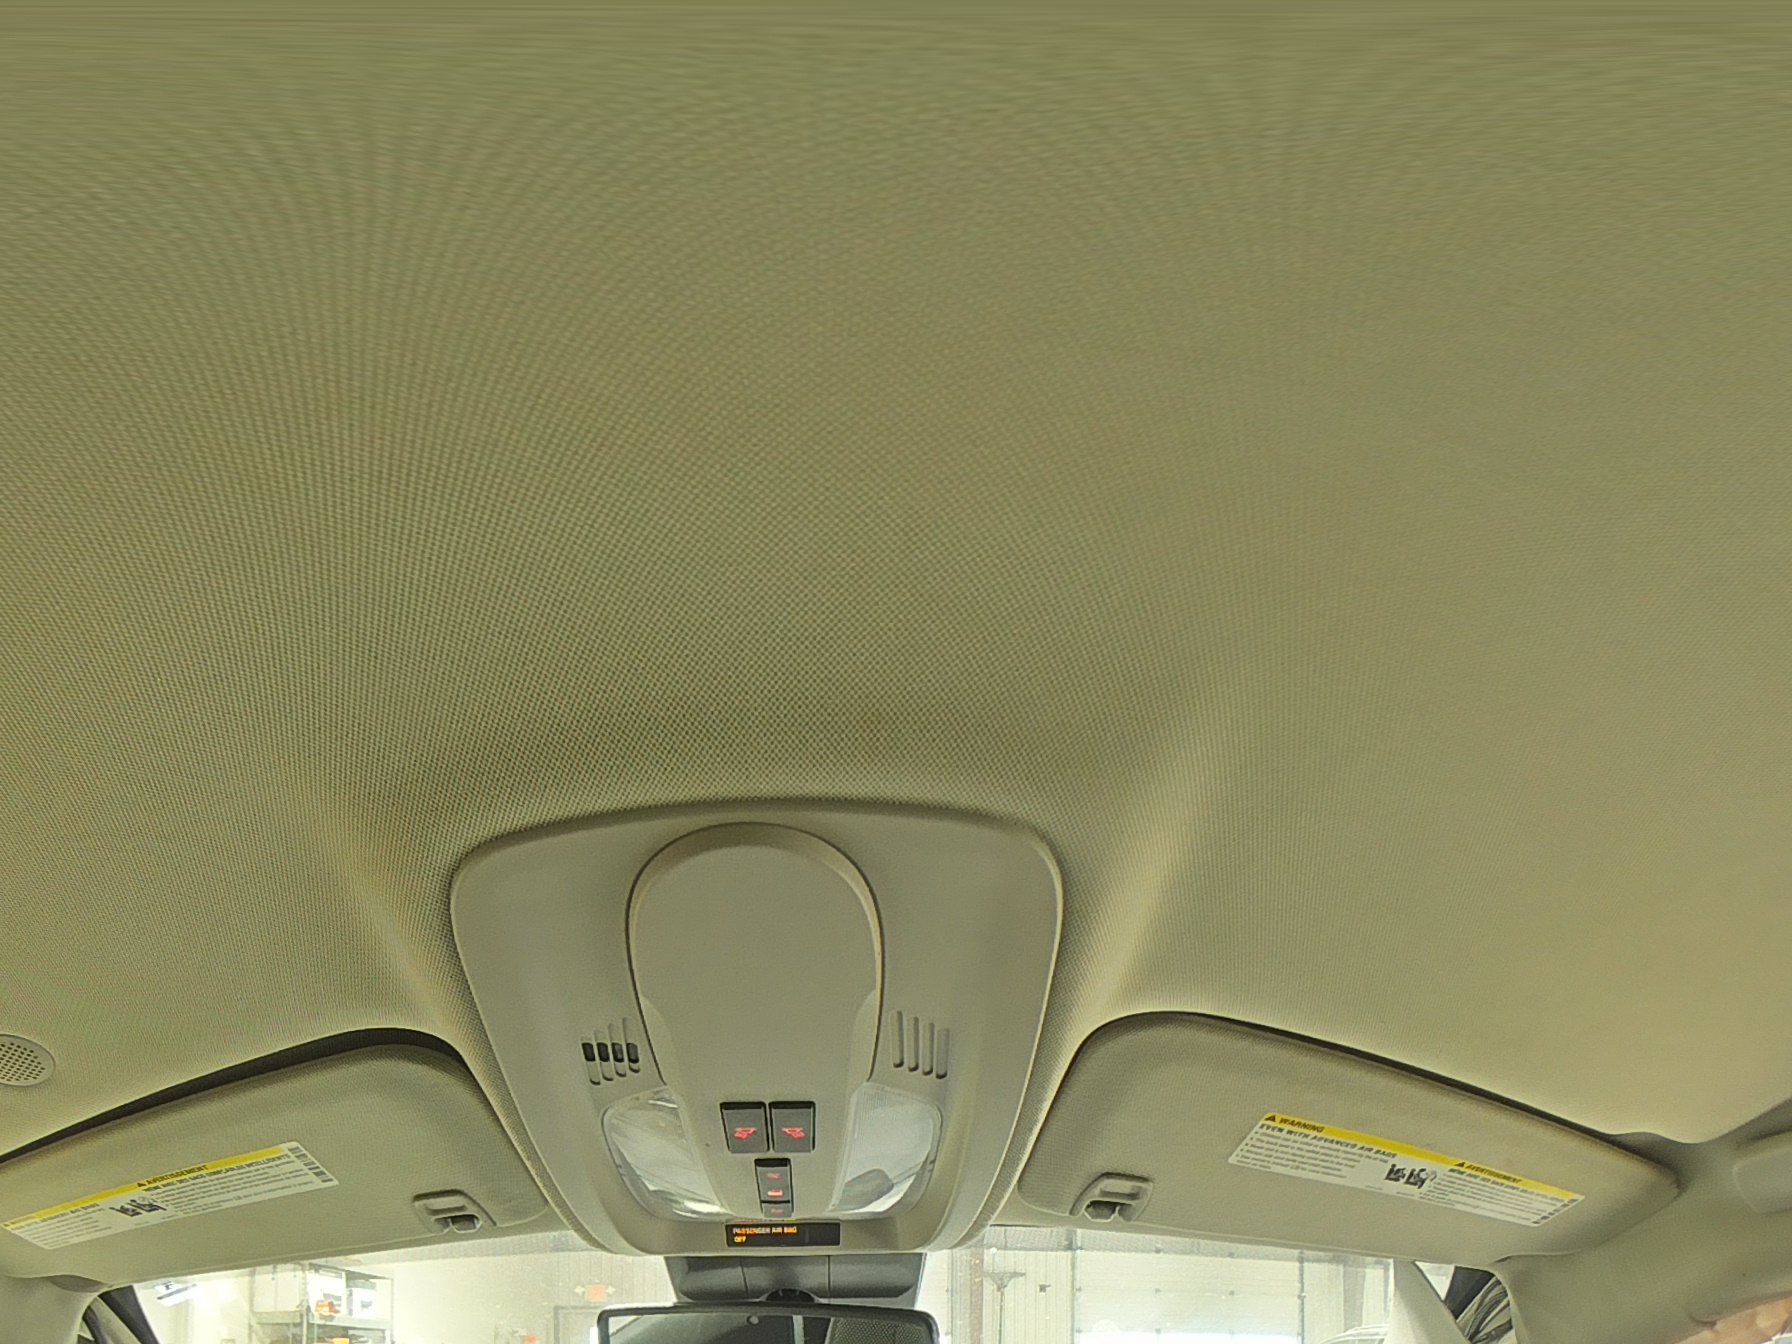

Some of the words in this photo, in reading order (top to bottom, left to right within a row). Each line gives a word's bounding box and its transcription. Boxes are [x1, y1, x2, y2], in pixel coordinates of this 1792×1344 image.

[1259, 1123, 1285, 1134] EVEN
[1286, 1128, 1311, 1140] WITH
[1278, 1116, 1325, 1134] WARNING
